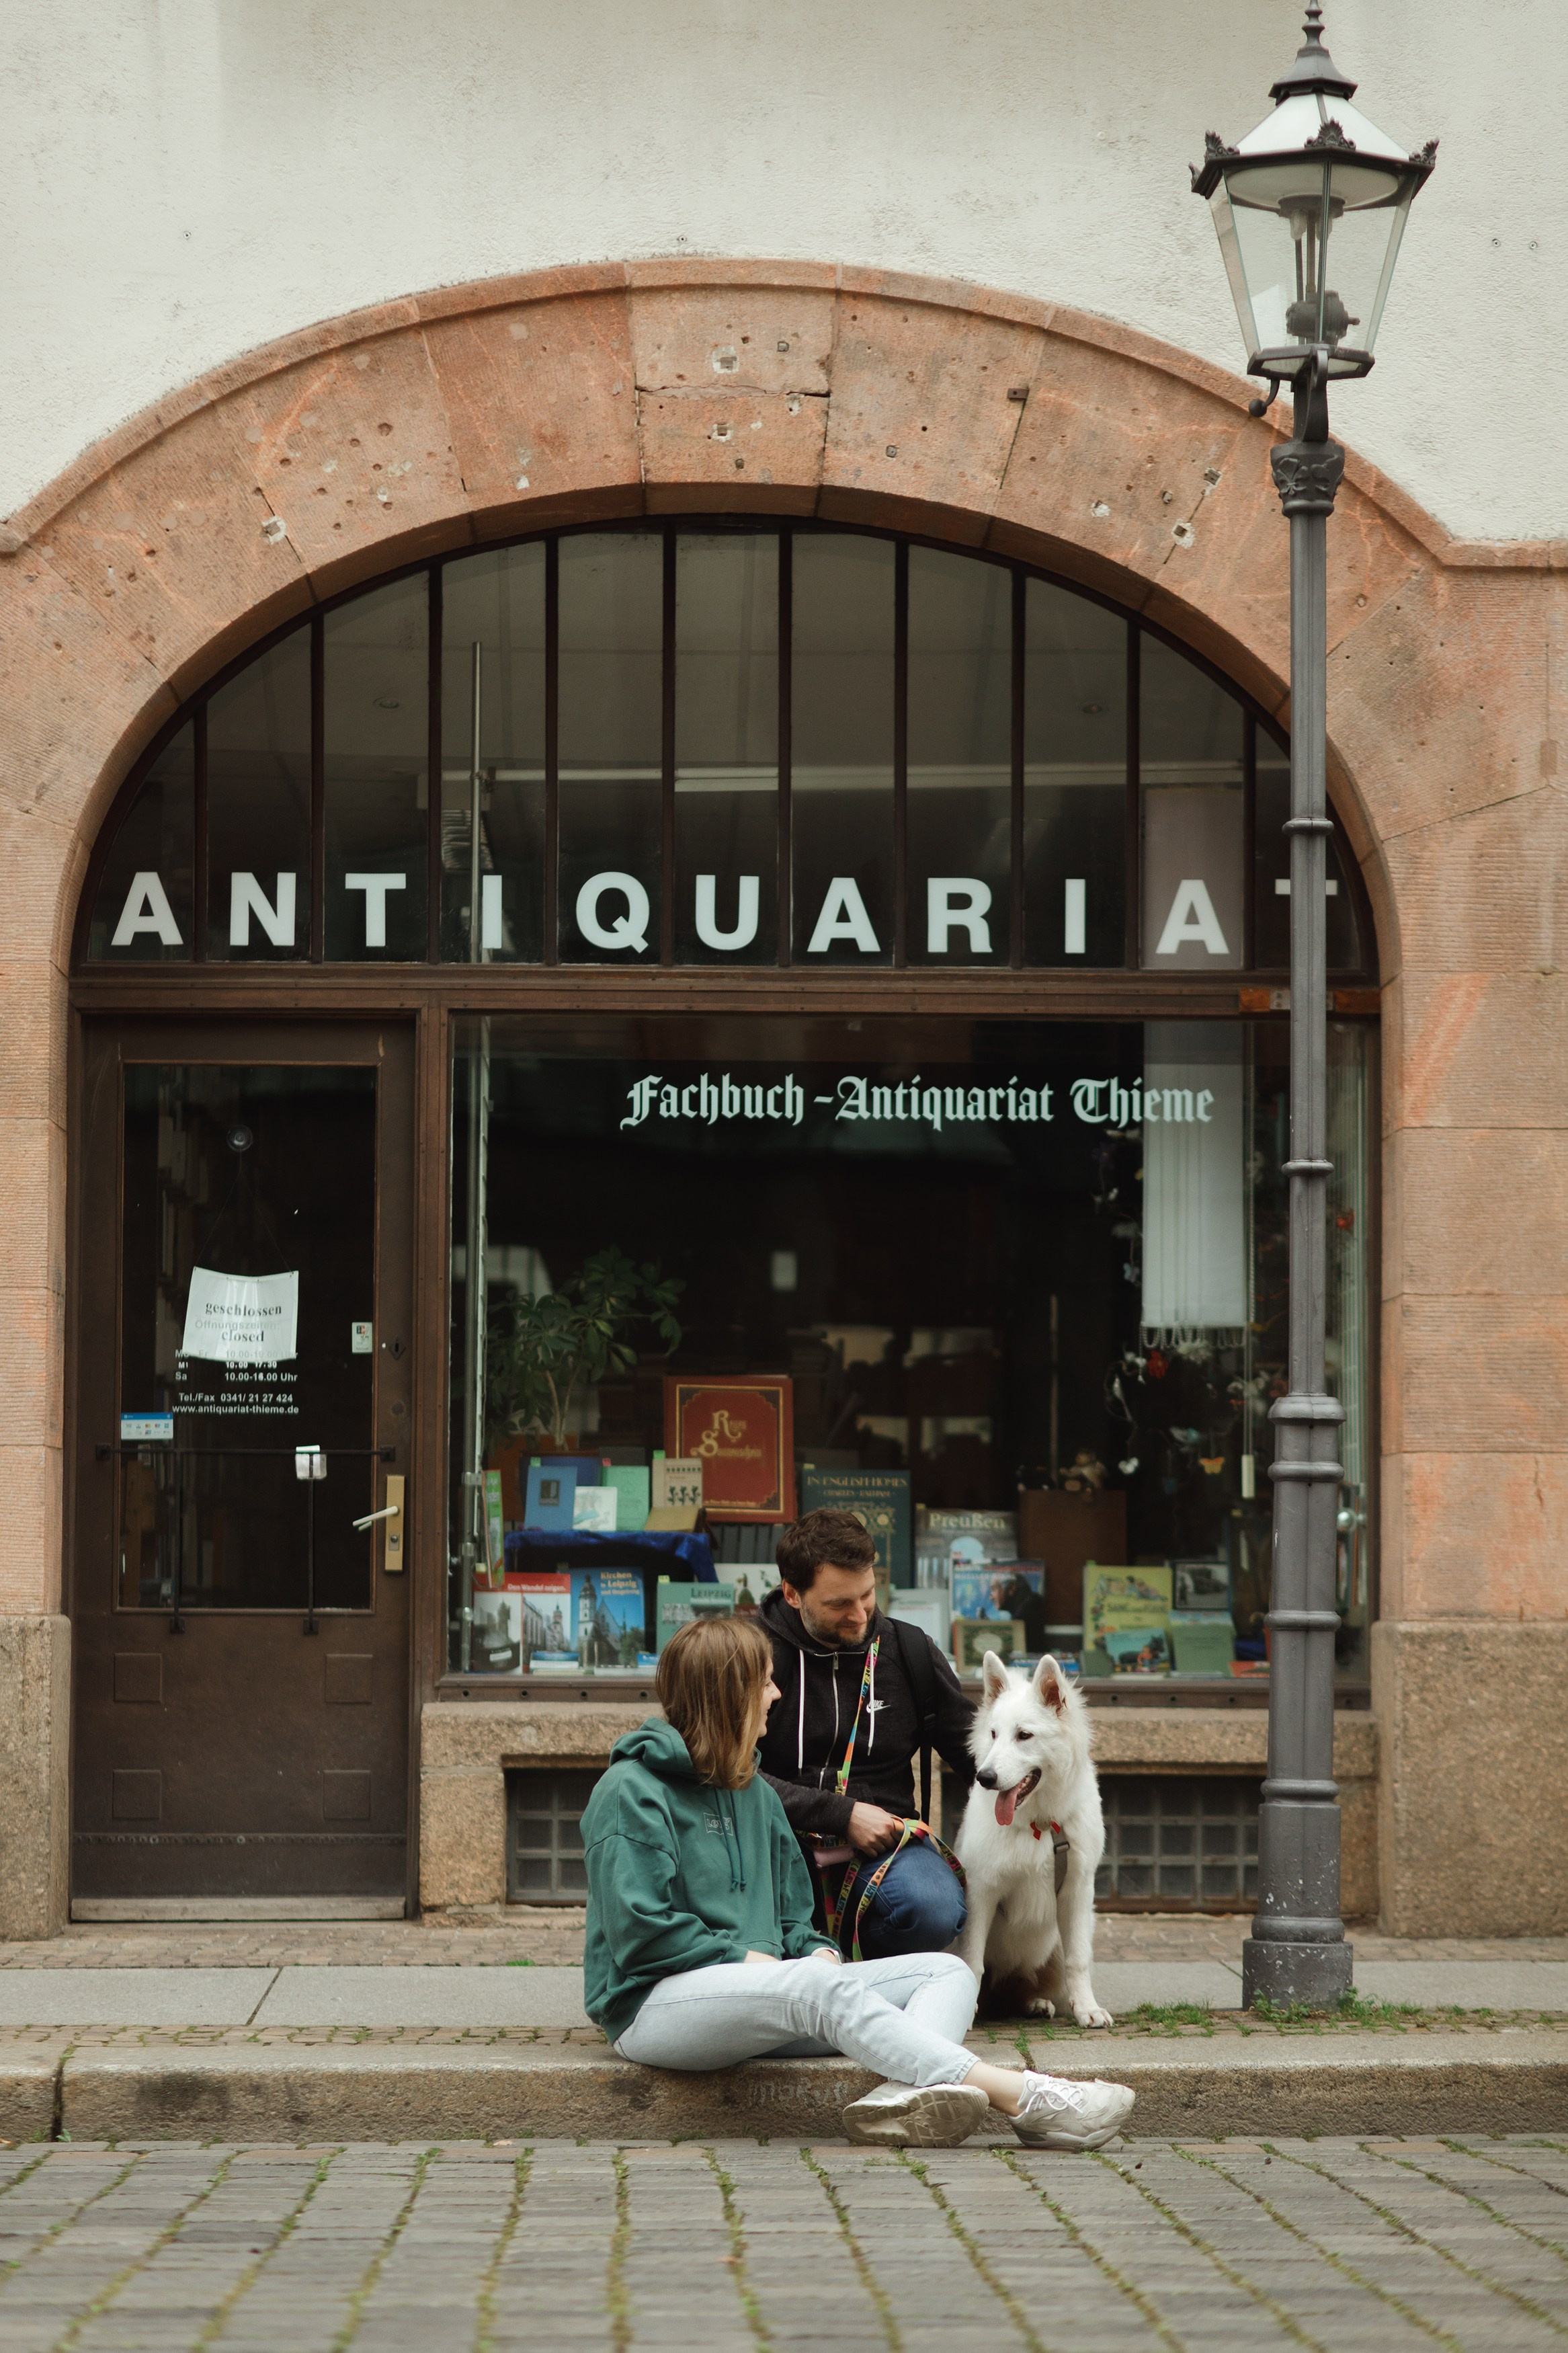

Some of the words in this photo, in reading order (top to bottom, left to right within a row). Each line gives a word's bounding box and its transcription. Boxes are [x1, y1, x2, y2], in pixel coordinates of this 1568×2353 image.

[1069, 1076, 1214, 1128] Thieme
[206, 1302, 282, 1316] geschlossen
[195, 1318, 280, 1331] Öffnungszeiten:
[222, 1330, 264, 1342] closed
[175, 1371, 187, 1380] Sa
[280, 1372, 298, 1381] Uhr
[179, 1392, 215, 1402] Tel./Fax
[220, 1393, 246, 1402] 0341/
[248, 1393, 259, 1402] 21
[262, 1393, 274, 1402] 27
[276, 1393, 293, 1402] 424
[172, 1404, 299, 1415] www.antiquariat-thieme.de
[929, 1513, 1005, 1529] Preußen
[600, 1572, 632, 1580] Kirchen
[608, 1580, 636, 1589] Leipzig
